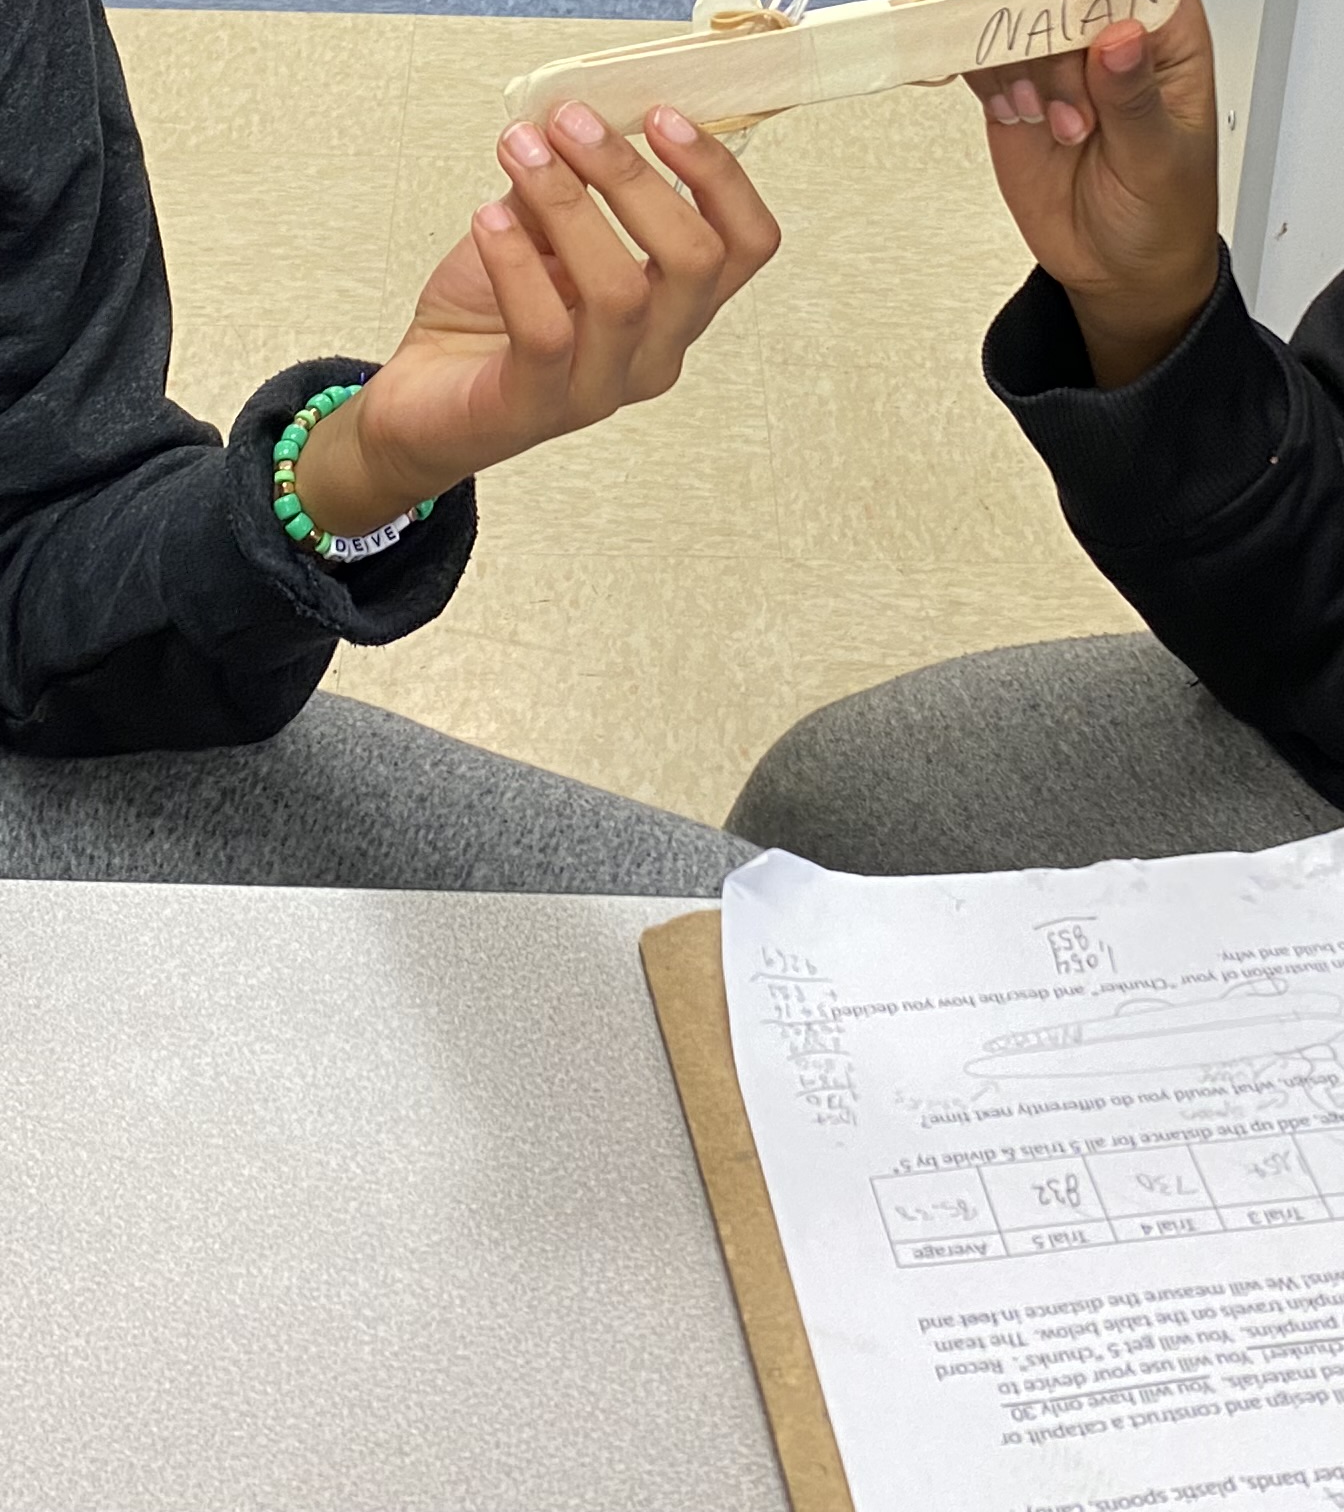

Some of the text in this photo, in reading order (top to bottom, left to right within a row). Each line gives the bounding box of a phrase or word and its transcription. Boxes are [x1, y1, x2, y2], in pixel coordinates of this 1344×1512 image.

[1259, 946, 1290, 963] and
[1292, 942, 1334, 960] build
[1180, 967, 1218, 986] your
[1242, 960, 1328, 981] illustration
[938, 994, 976, 1009] how
[979, 987, 1050, 1006] describe
[1052, 984, 1085, 1000] and
[830, 1001, 897, 1021] decided
[901, 993, 934, 1012] you
[1137, 1087, 1169, 1105] you
[1173, 1085, 1229, 1105] would
[1231, 1080, 1274, 1098] what
[976, 1107, 1013, 1124] next
[1017, 1098, 1106, 1120] differently
[920, 1111, 971, 1130] time?
[1276, 1118, 1311, 1135] add
[1140, 1128, 1214, 1146] distance
[1217, 1124, 1248, 1140] the
[1020, 1142, 1064, 1160] trials
[1084, 1138, 1107, 1155] all
[1110, 1135, 1136, 1150] for
[942, 1150, 996, 1168] divide
[1031, 1172, 1081, 1208] 832
[1247, 1207, 1302, 1226] Trial 3
[1140, 1219, 1196, 1238] Trial 4
[1032, 1231, 1087, 1250] Trial 5
[912, 1242, 988, 1261] Average
[1144, 1284, 1224, 1303] measure
[1228, 1280, 1260, 1298] will
[1262, 1276, 1296, 1292] We
[1024, 1298, 1104, 1318] distance
[1107, 1293, 1140, 1310] the
[1220, 1299, 1282, 1320] travels
[917, 1316, 955, 1334] and
[1103, 1314, 1152, 1334] table
[1156, 1310, 1188, 1327] the
[1240, 1314, 1338, 1339] pumpkins.
[990, 1330, 1026, 1348] The
[1034, 1321, 1099, 1340] below.
[1198, 1329, 1235, 1345] You
[934, 1335, 986, 1351] team
[1126, 1333, 1155, 1354] get
[1159, 1334, 1195, 1352] will
[1262, 1341, 1344, 1364] chunker!
[1139, 1359, 1174, 1374] use
[1177, 1355, 1213, 1374] will
[1215, 1350, 1253, 1366] You
[934, 1357, 1003, 1380] Record
[1093, 1360, 1135, 1381] your
[1023, 1371, 1088, 1391] device
[1176, 1380, 1214, 1396] You
[1221, 1368, 1316, 1392] materials.
[1087, 1391, 1135, 1408] have
[1138, 1386, 1173, 1405] will
[1266, 1390, 1328, 1408] design
[1010, 1405, 1037, 1422] 30
[1040, 1398, 1084, 1417] only
[1127, 1403, 1221, 1429] construct
[1224, 1397, 1263, 1416] and
[1027, 1419, 1108, 1443] catapult
[1173, 1475, 1236, 1500] plastic
[1240, 1471, 1308, 1491] bands,
